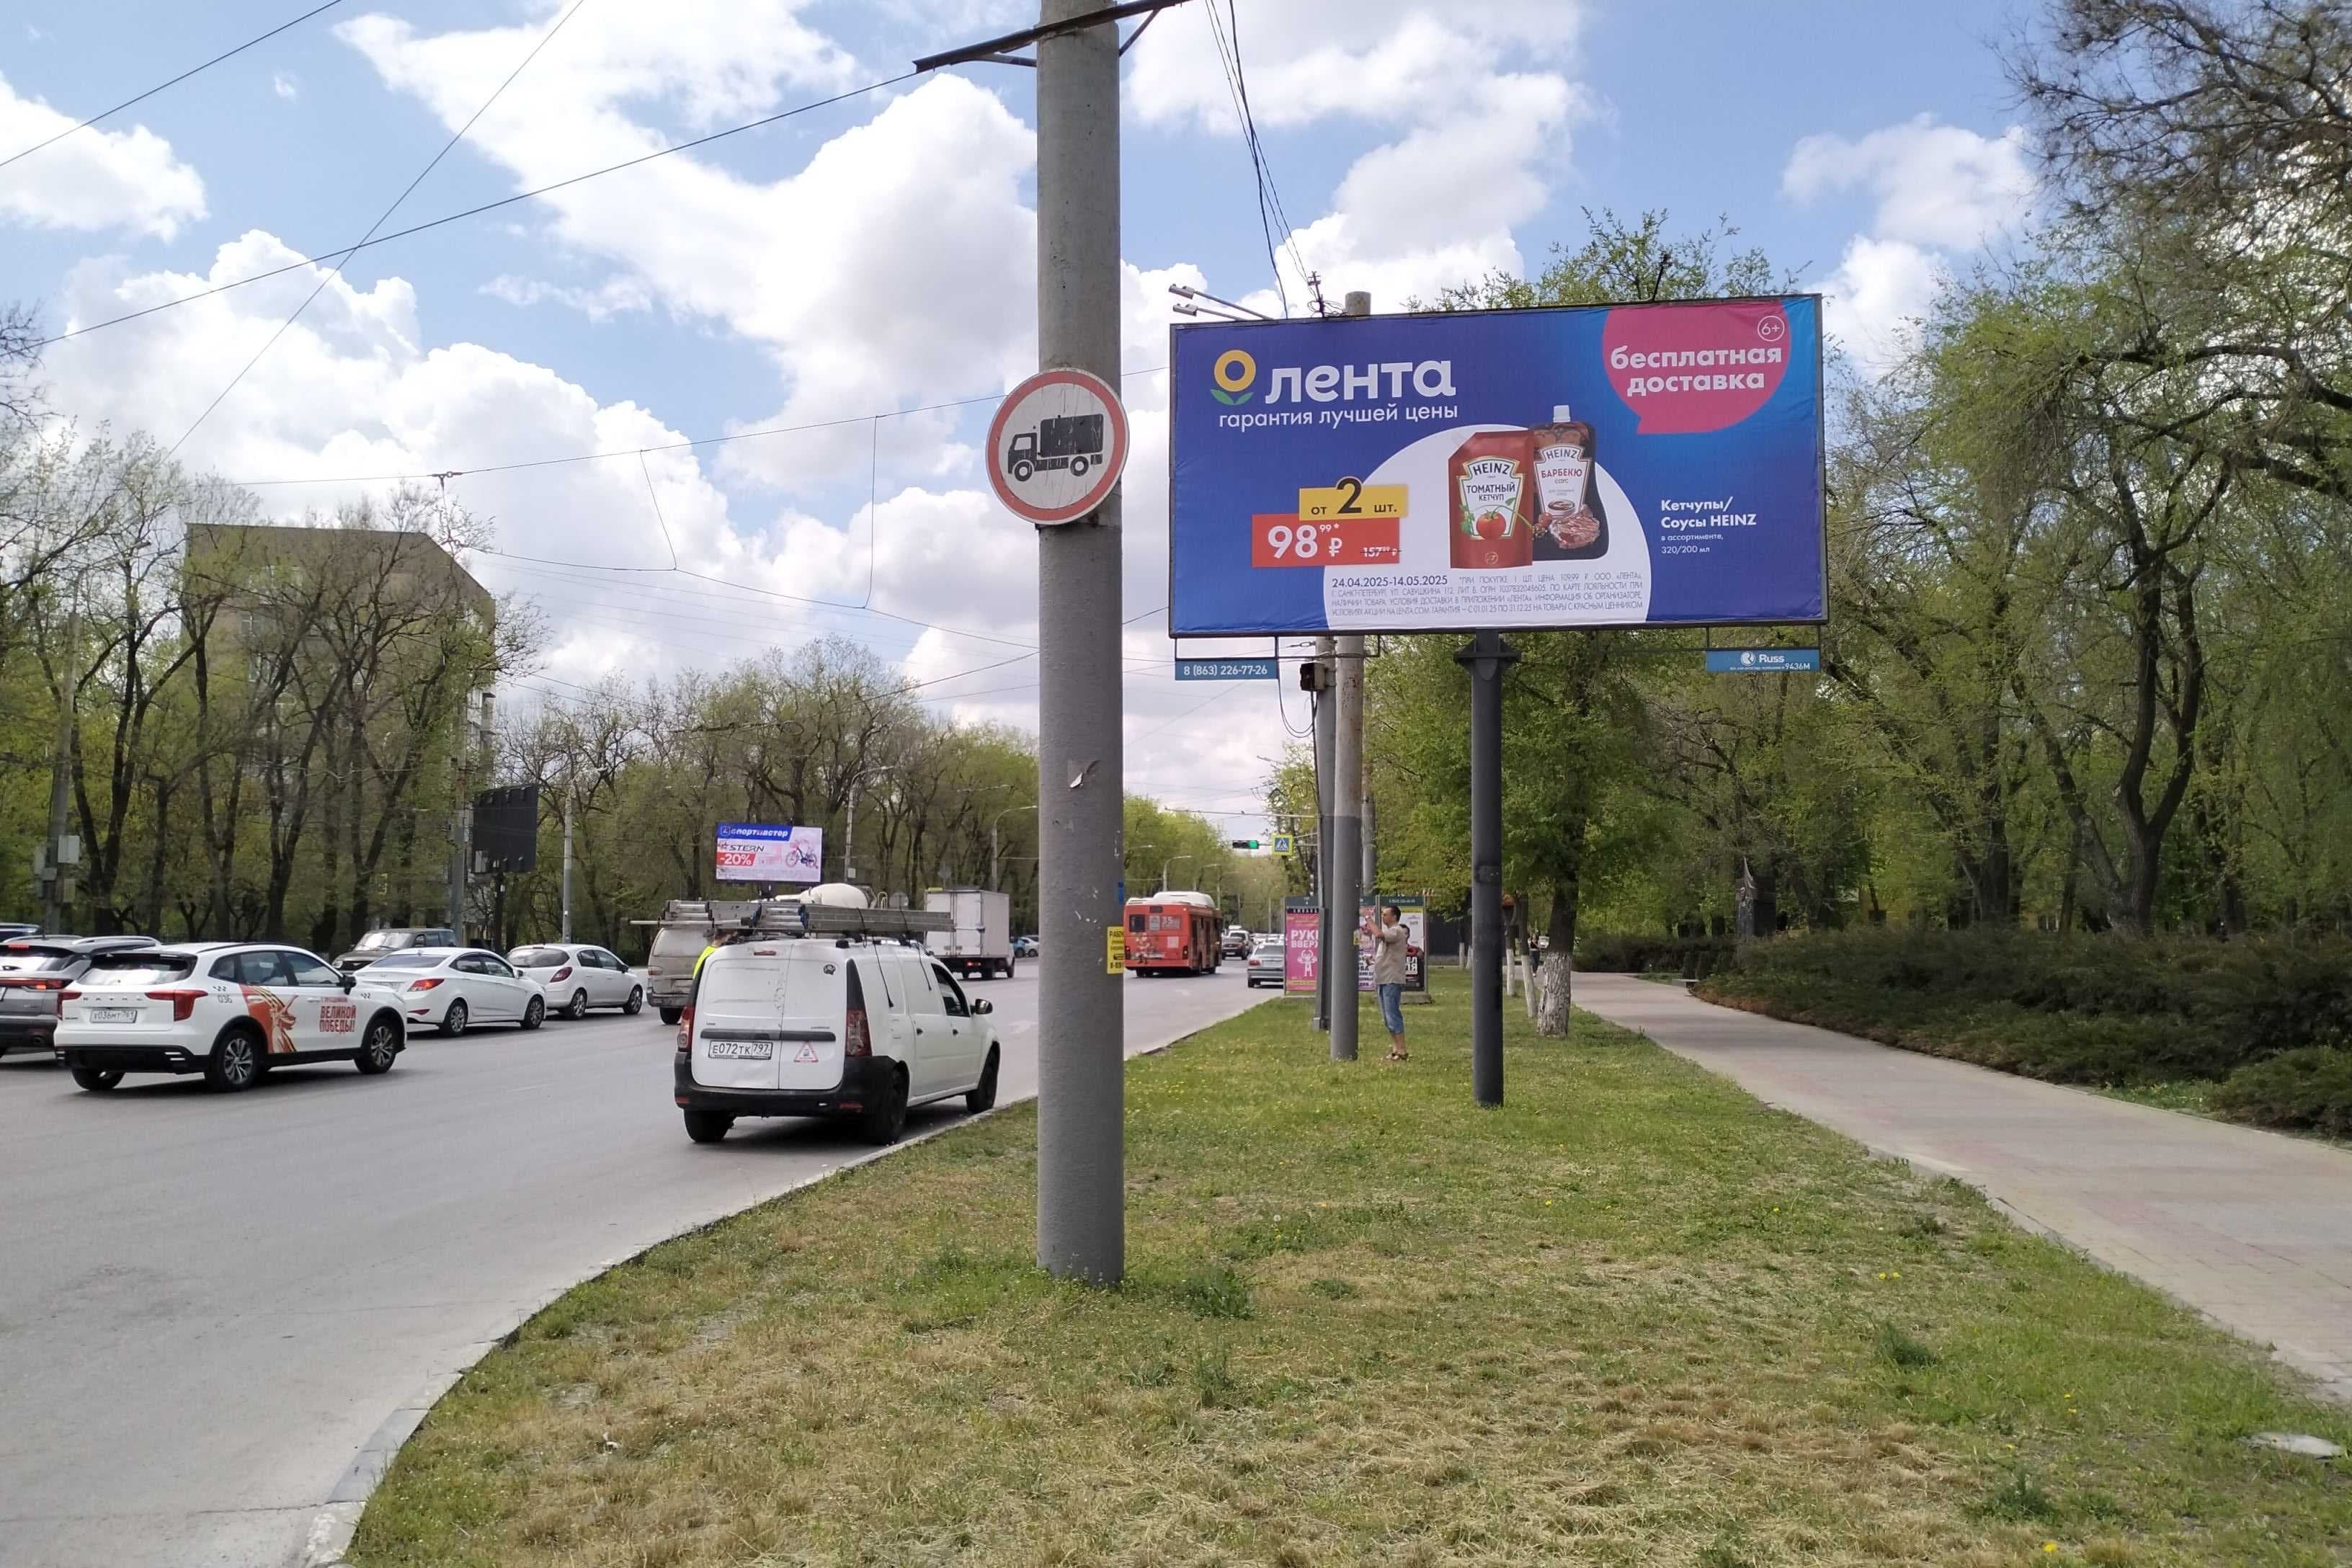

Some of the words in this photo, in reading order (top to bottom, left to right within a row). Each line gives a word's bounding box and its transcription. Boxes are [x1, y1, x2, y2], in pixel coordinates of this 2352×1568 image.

[1760, 323, 1781, 335] 6+
[1610, 345, 1782, 369] бесплатная
[1265, 360, 1456, 404] лента
[1626, 373, 1765, 396] доставка
[1219, 411, 1313, 432] гарантия
[1319, 404, 1398, 429] лучшей
[1405, 405, 1458, 422] цены
[1546, 448, 1578, 459] HEINZ
[1472, 463, 1510, 476] HEINZ
[1541, 468, 1582, 478] БАРБЕКЮ
[1466, 482, 1515, 494] ТОМАТНЫЙ
[1336, 477, 1362, 514] 2
[1373, 504, 1397, 512] шт.
[1661, 496, 1734, 513] Кетчупы/
[1661, 517, 1706, 531] Соусы
[1711, 514, 1757, 527] HEINZ
[1268, 525, 1318, 558] 98
[1661, 545, 1698, 554] 320/200
[1332, 576, 1448, 587] 24.04.2025-14.05.2025
[1759, 654, 1785, 663] Russ
[1184, 666, 1190, 675] 8
[1193, 664, 1217, 676] (863)
[1221, 665, 1268, 675] 226-77-26
[728, 844, 765, 852] STERN
[720, 853, 752, 865] -20%
[320, 1005, 357, 1018] ВЕЛИКОЙ
[712, 1043, 751, 1055] Е072ТК
[754, 1043, 769, 1053] 797
